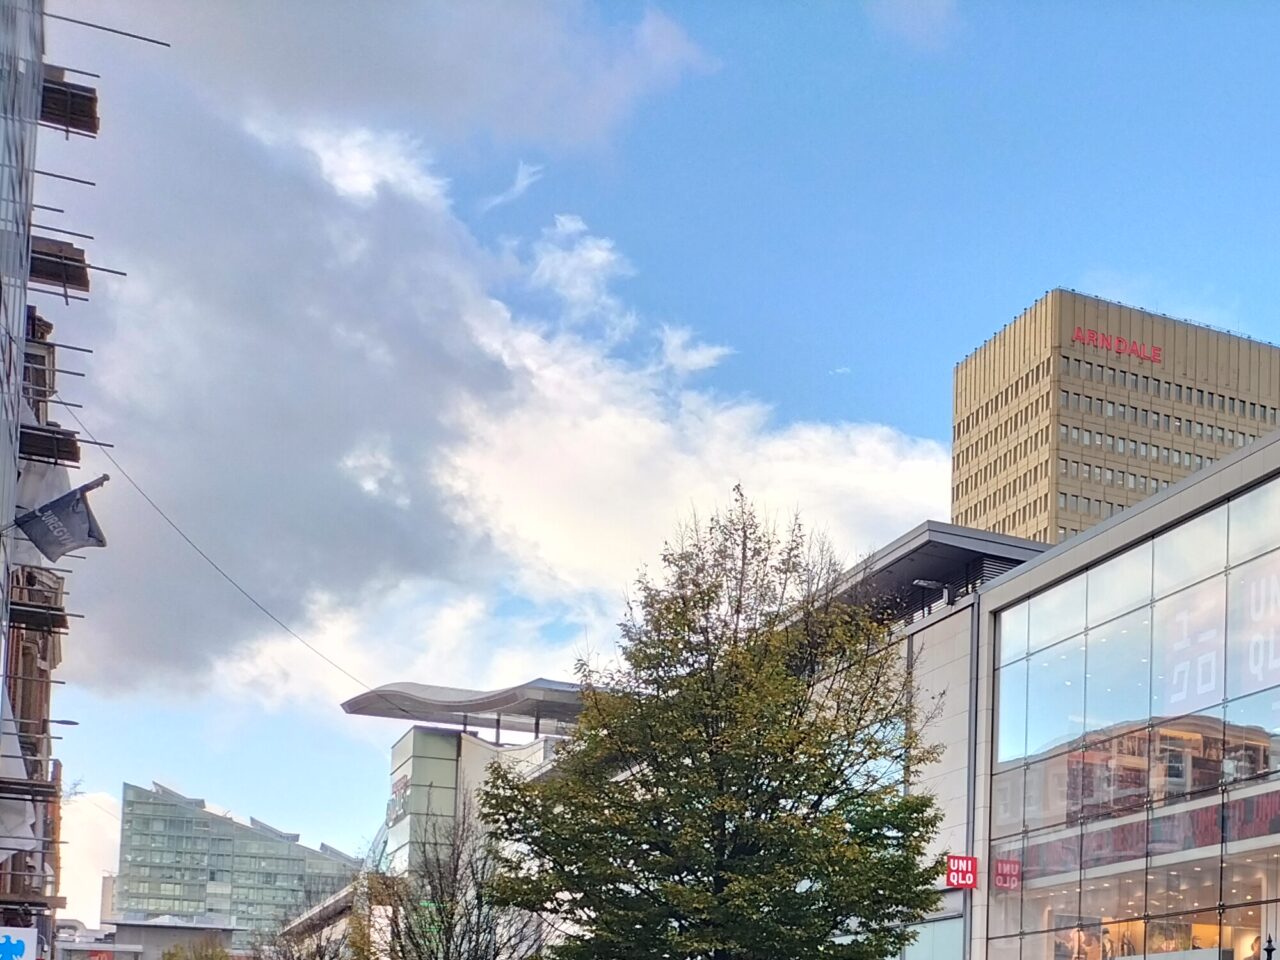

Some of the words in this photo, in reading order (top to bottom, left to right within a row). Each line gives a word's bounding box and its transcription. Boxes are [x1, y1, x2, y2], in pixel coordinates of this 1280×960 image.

[1072, 326, 1163, 364] ARNDALE
[950, 859, 972, 871] UNI
[950, 872, 973, 885] QLO
